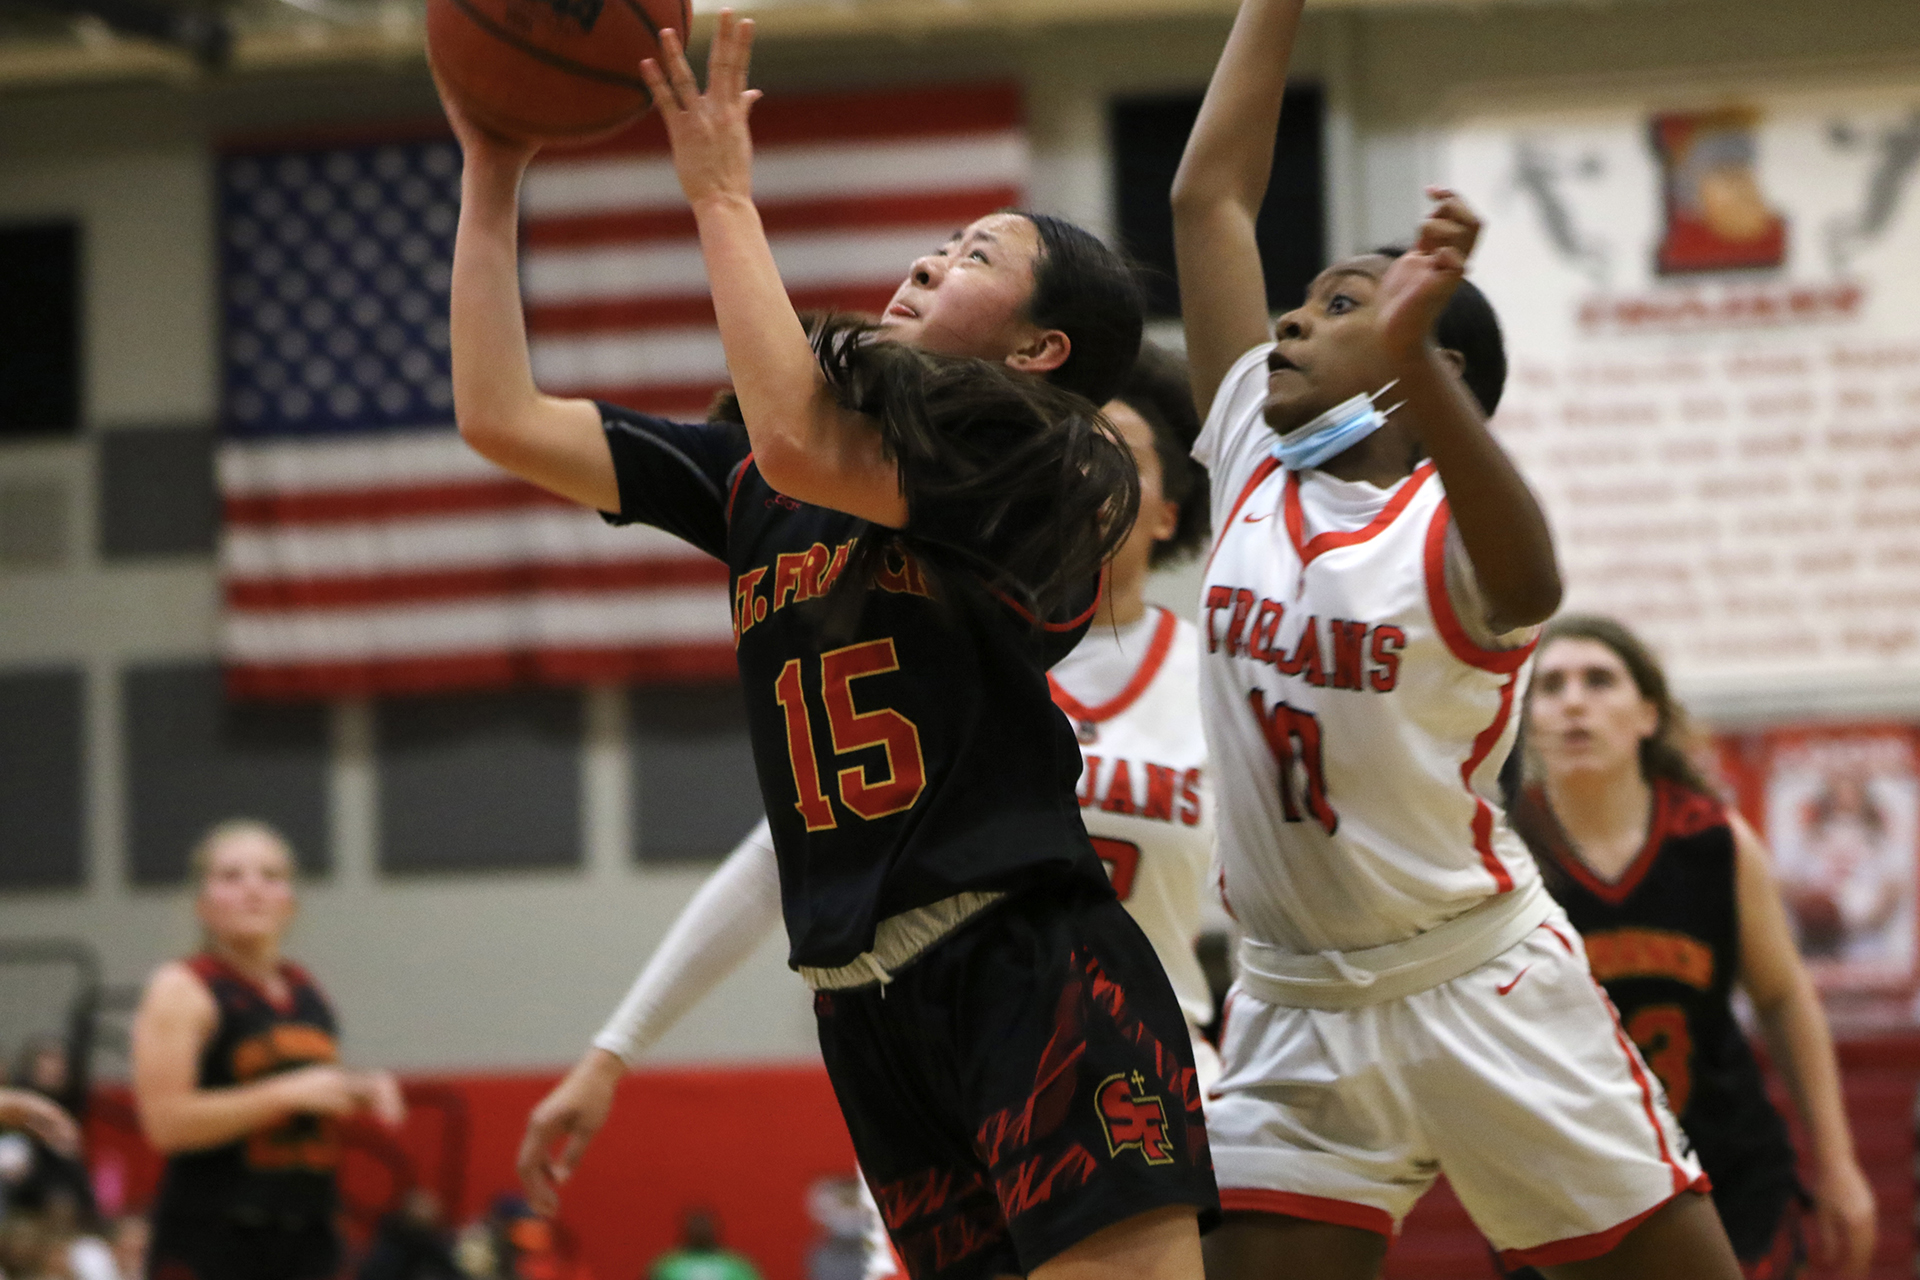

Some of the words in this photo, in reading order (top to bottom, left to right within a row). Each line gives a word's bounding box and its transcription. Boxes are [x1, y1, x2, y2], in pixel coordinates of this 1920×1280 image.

[1205, 585, 1406, 692] TROJANS
[774, 636, 927, 832] 15
[1077, 756, 1201, 828] JANS
[1247, 687, 1338, 836] 10
